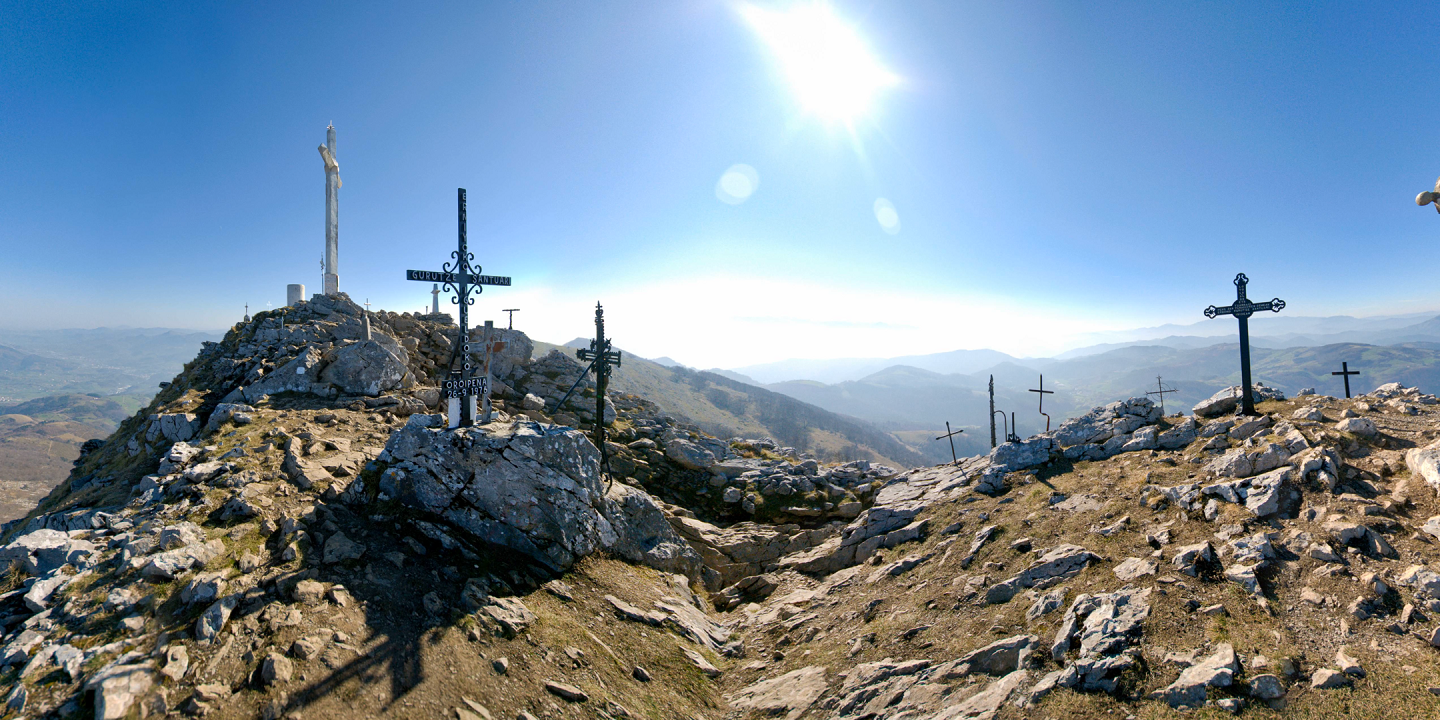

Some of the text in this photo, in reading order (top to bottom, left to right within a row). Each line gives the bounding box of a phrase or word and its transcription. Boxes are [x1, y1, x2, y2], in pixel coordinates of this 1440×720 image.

[412, 270, 511, 285] GURUTZE SANTUARI
[446, 378, 487, 390] OROIPENA
[447, 386, 488, 399] 26-9 1976
